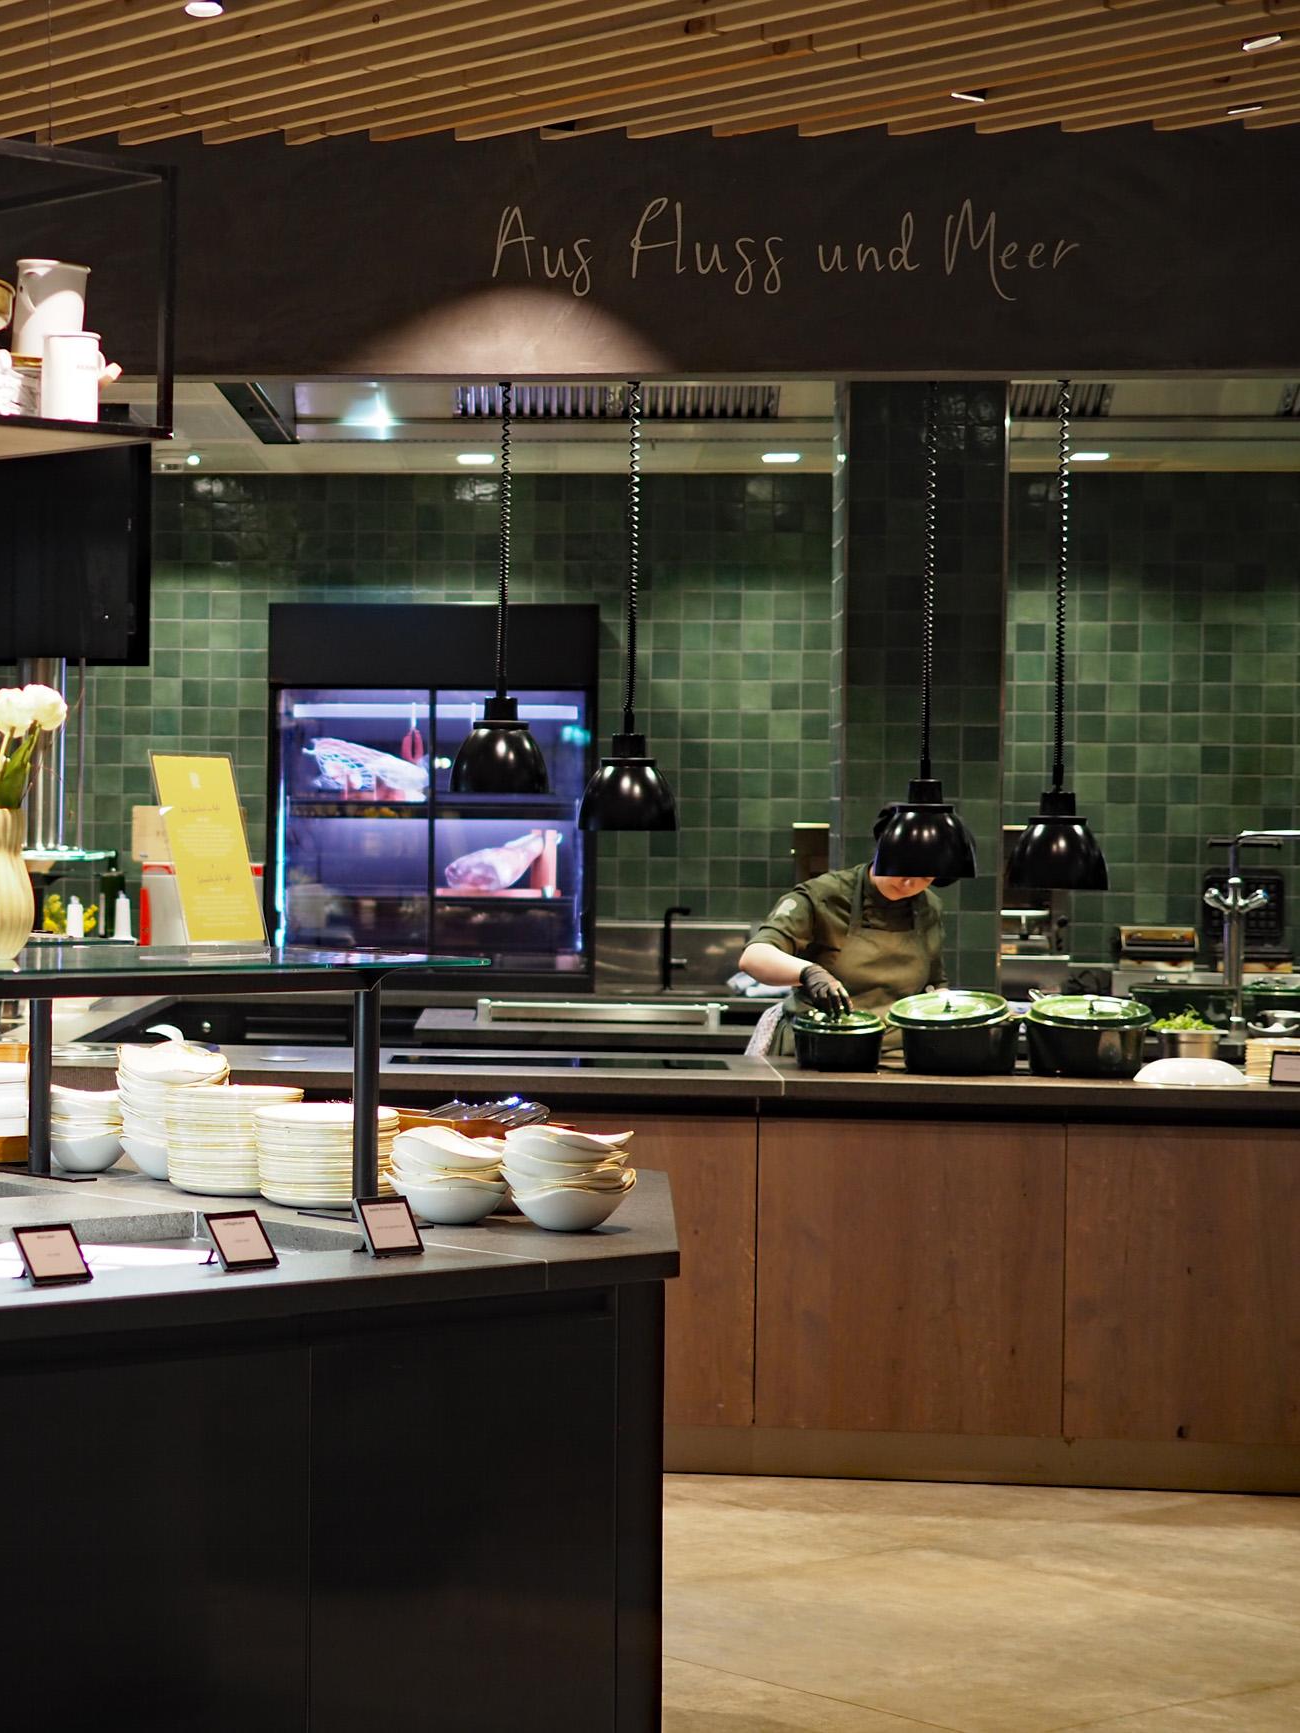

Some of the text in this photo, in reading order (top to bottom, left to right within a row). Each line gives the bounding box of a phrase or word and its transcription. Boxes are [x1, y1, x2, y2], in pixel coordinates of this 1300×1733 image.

[491, 196, 1081, 302] Aus Fluss und Meer
